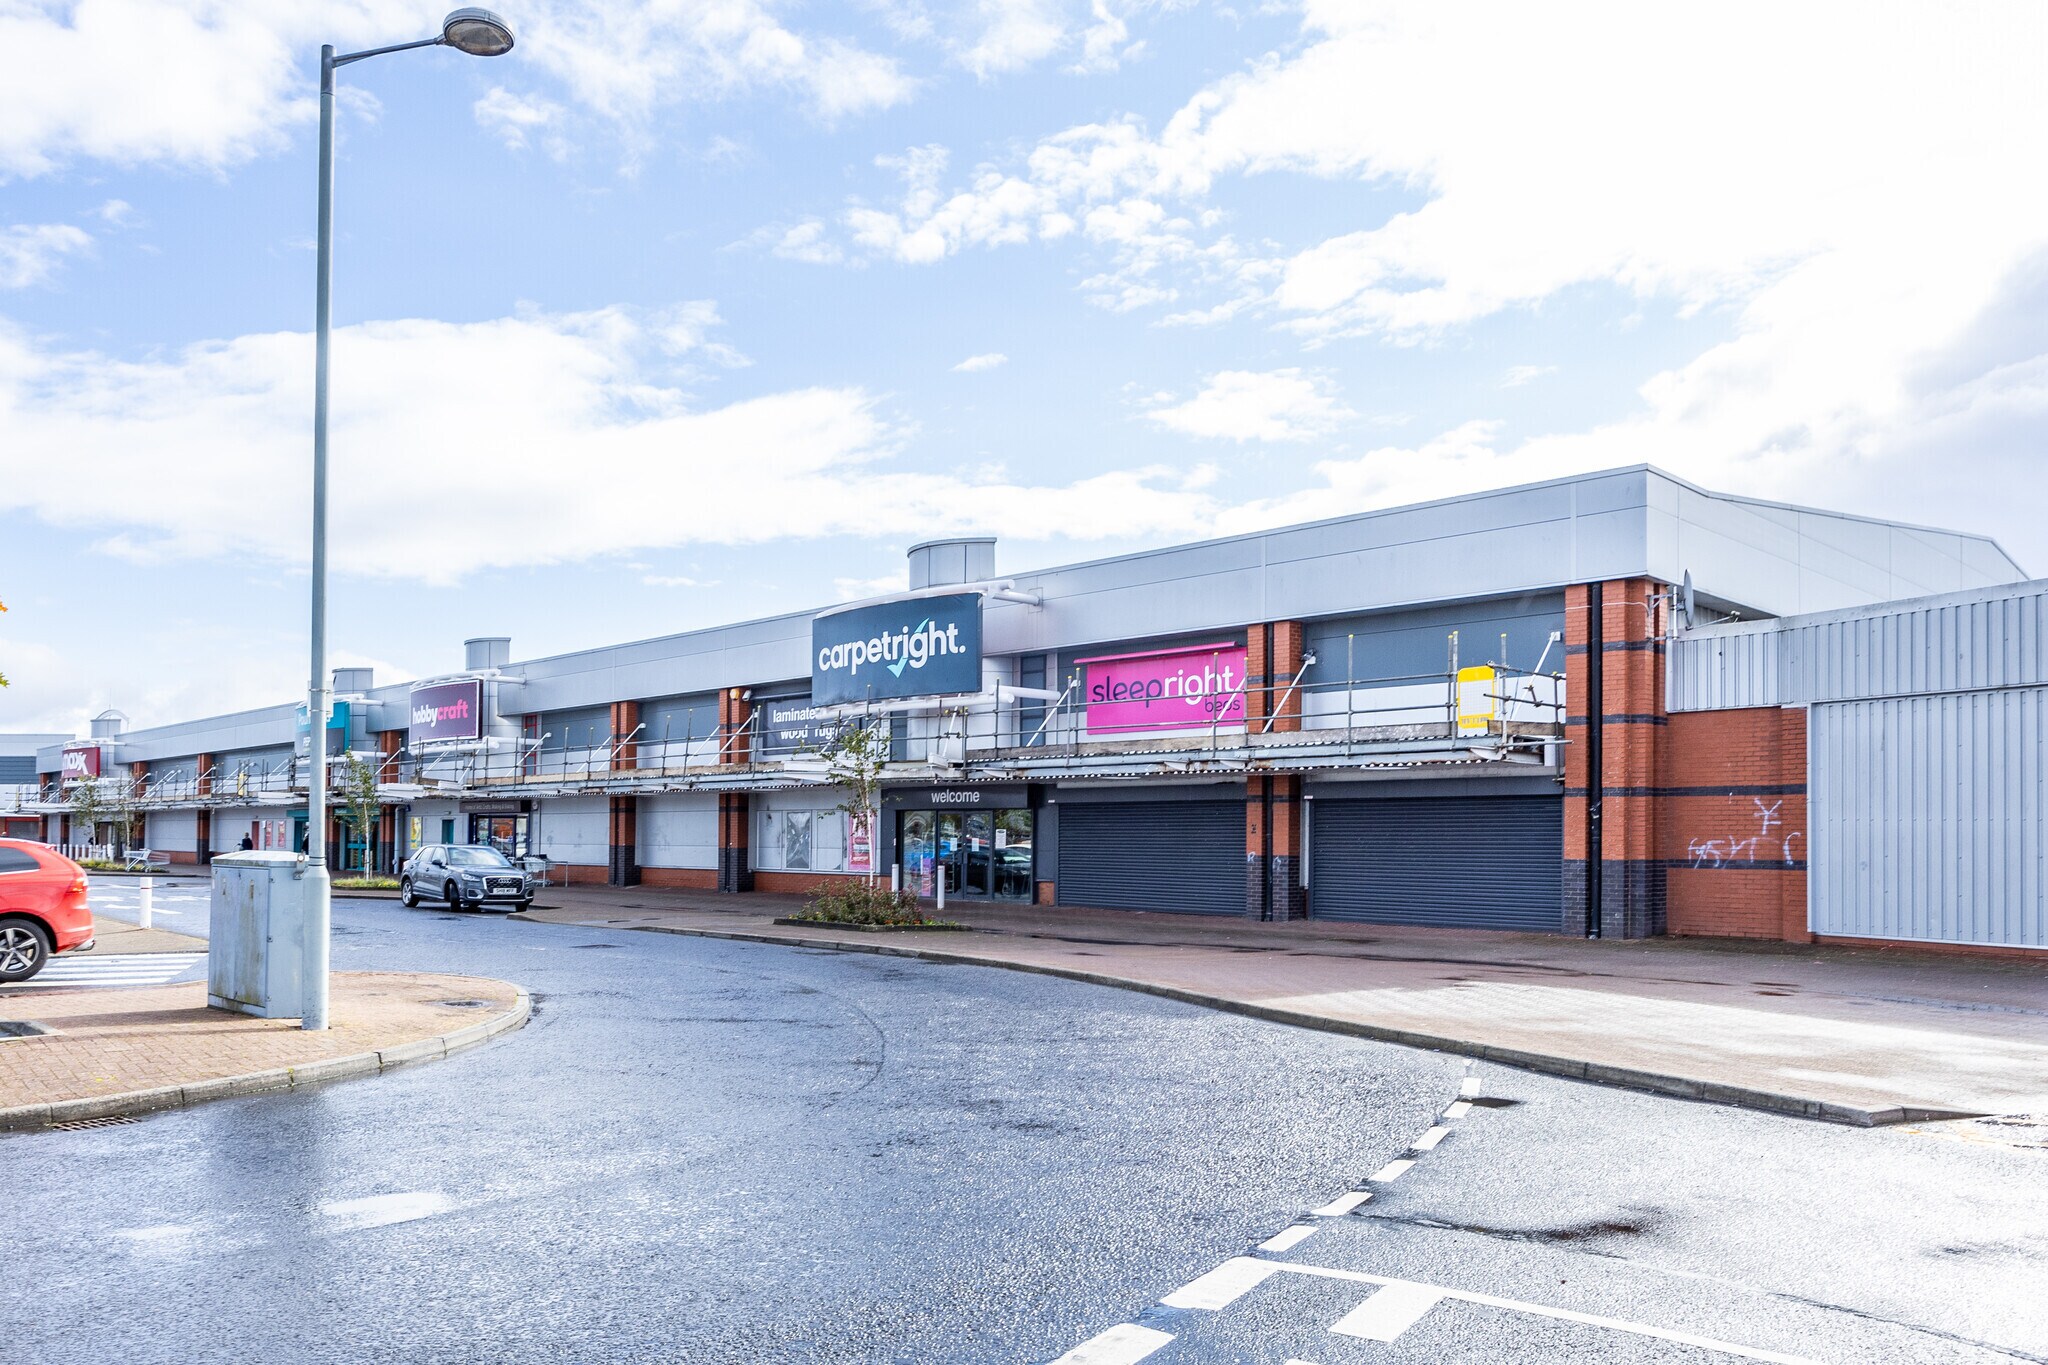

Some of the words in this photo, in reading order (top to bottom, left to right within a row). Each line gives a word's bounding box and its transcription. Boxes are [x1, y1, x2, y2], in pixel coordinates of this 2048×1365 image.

[1092, 665, 1235, 708] sleepright
[412, 699, 468, 728] hobbycraft
[780, 724, 808, 740] wood
[931, 789, 980, 803] welcome
